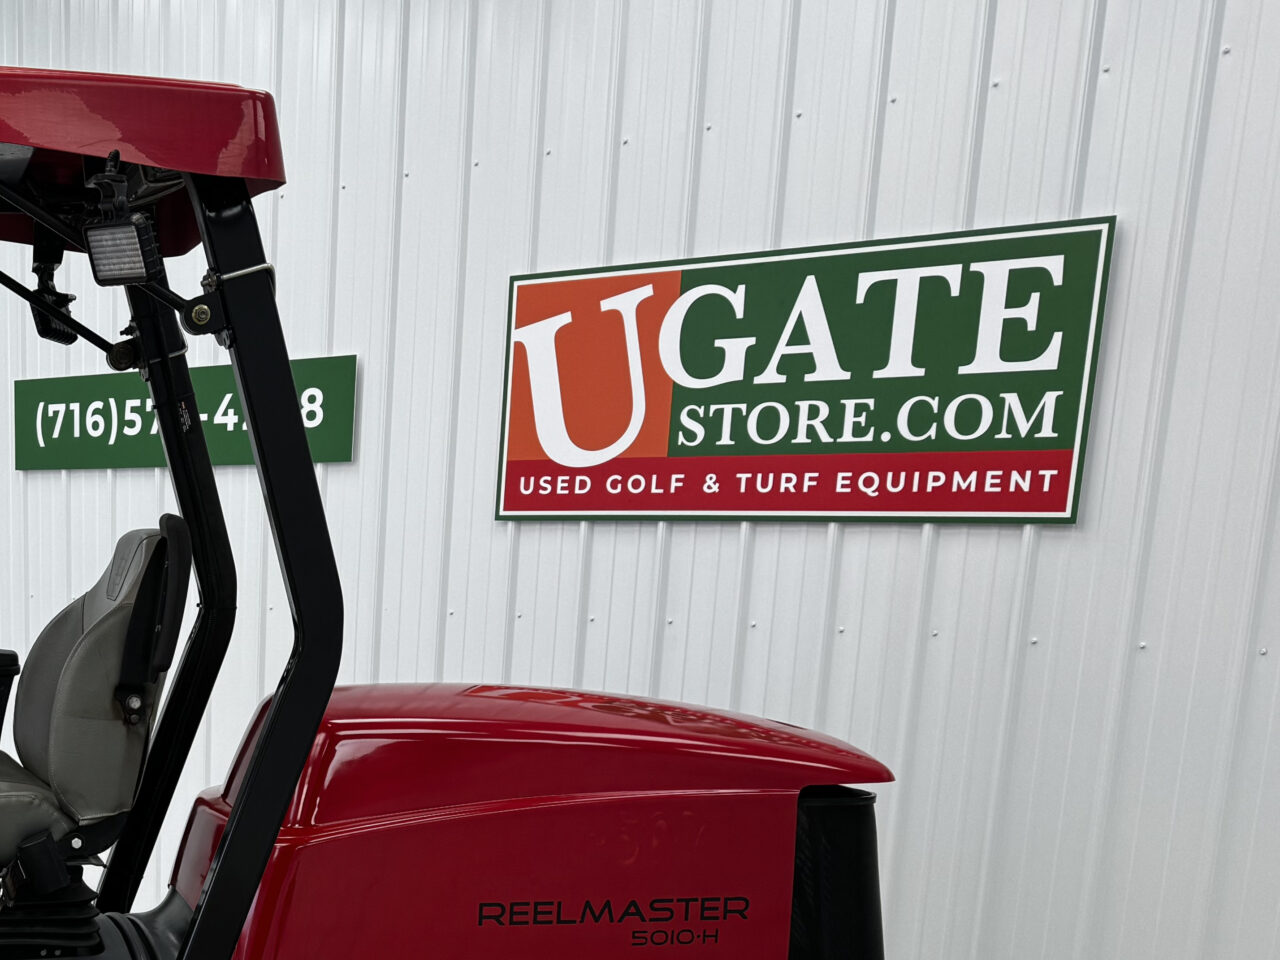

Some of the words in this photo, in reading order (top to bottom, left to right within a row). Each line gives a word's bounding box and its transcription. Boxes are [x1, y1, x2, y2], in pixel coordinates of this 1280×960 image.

[677, 390, 1064, 447] STORE.COM
[519, 475, 592, 495] USED
[605, 474, 686, 495] GOLF
[702, 473, 720, 493] &
[735, 472, 820, 494] TURF
[835, 469, 1058, 497] EQUIPMENT
[477, 896, 750, 926] REELMASTER
